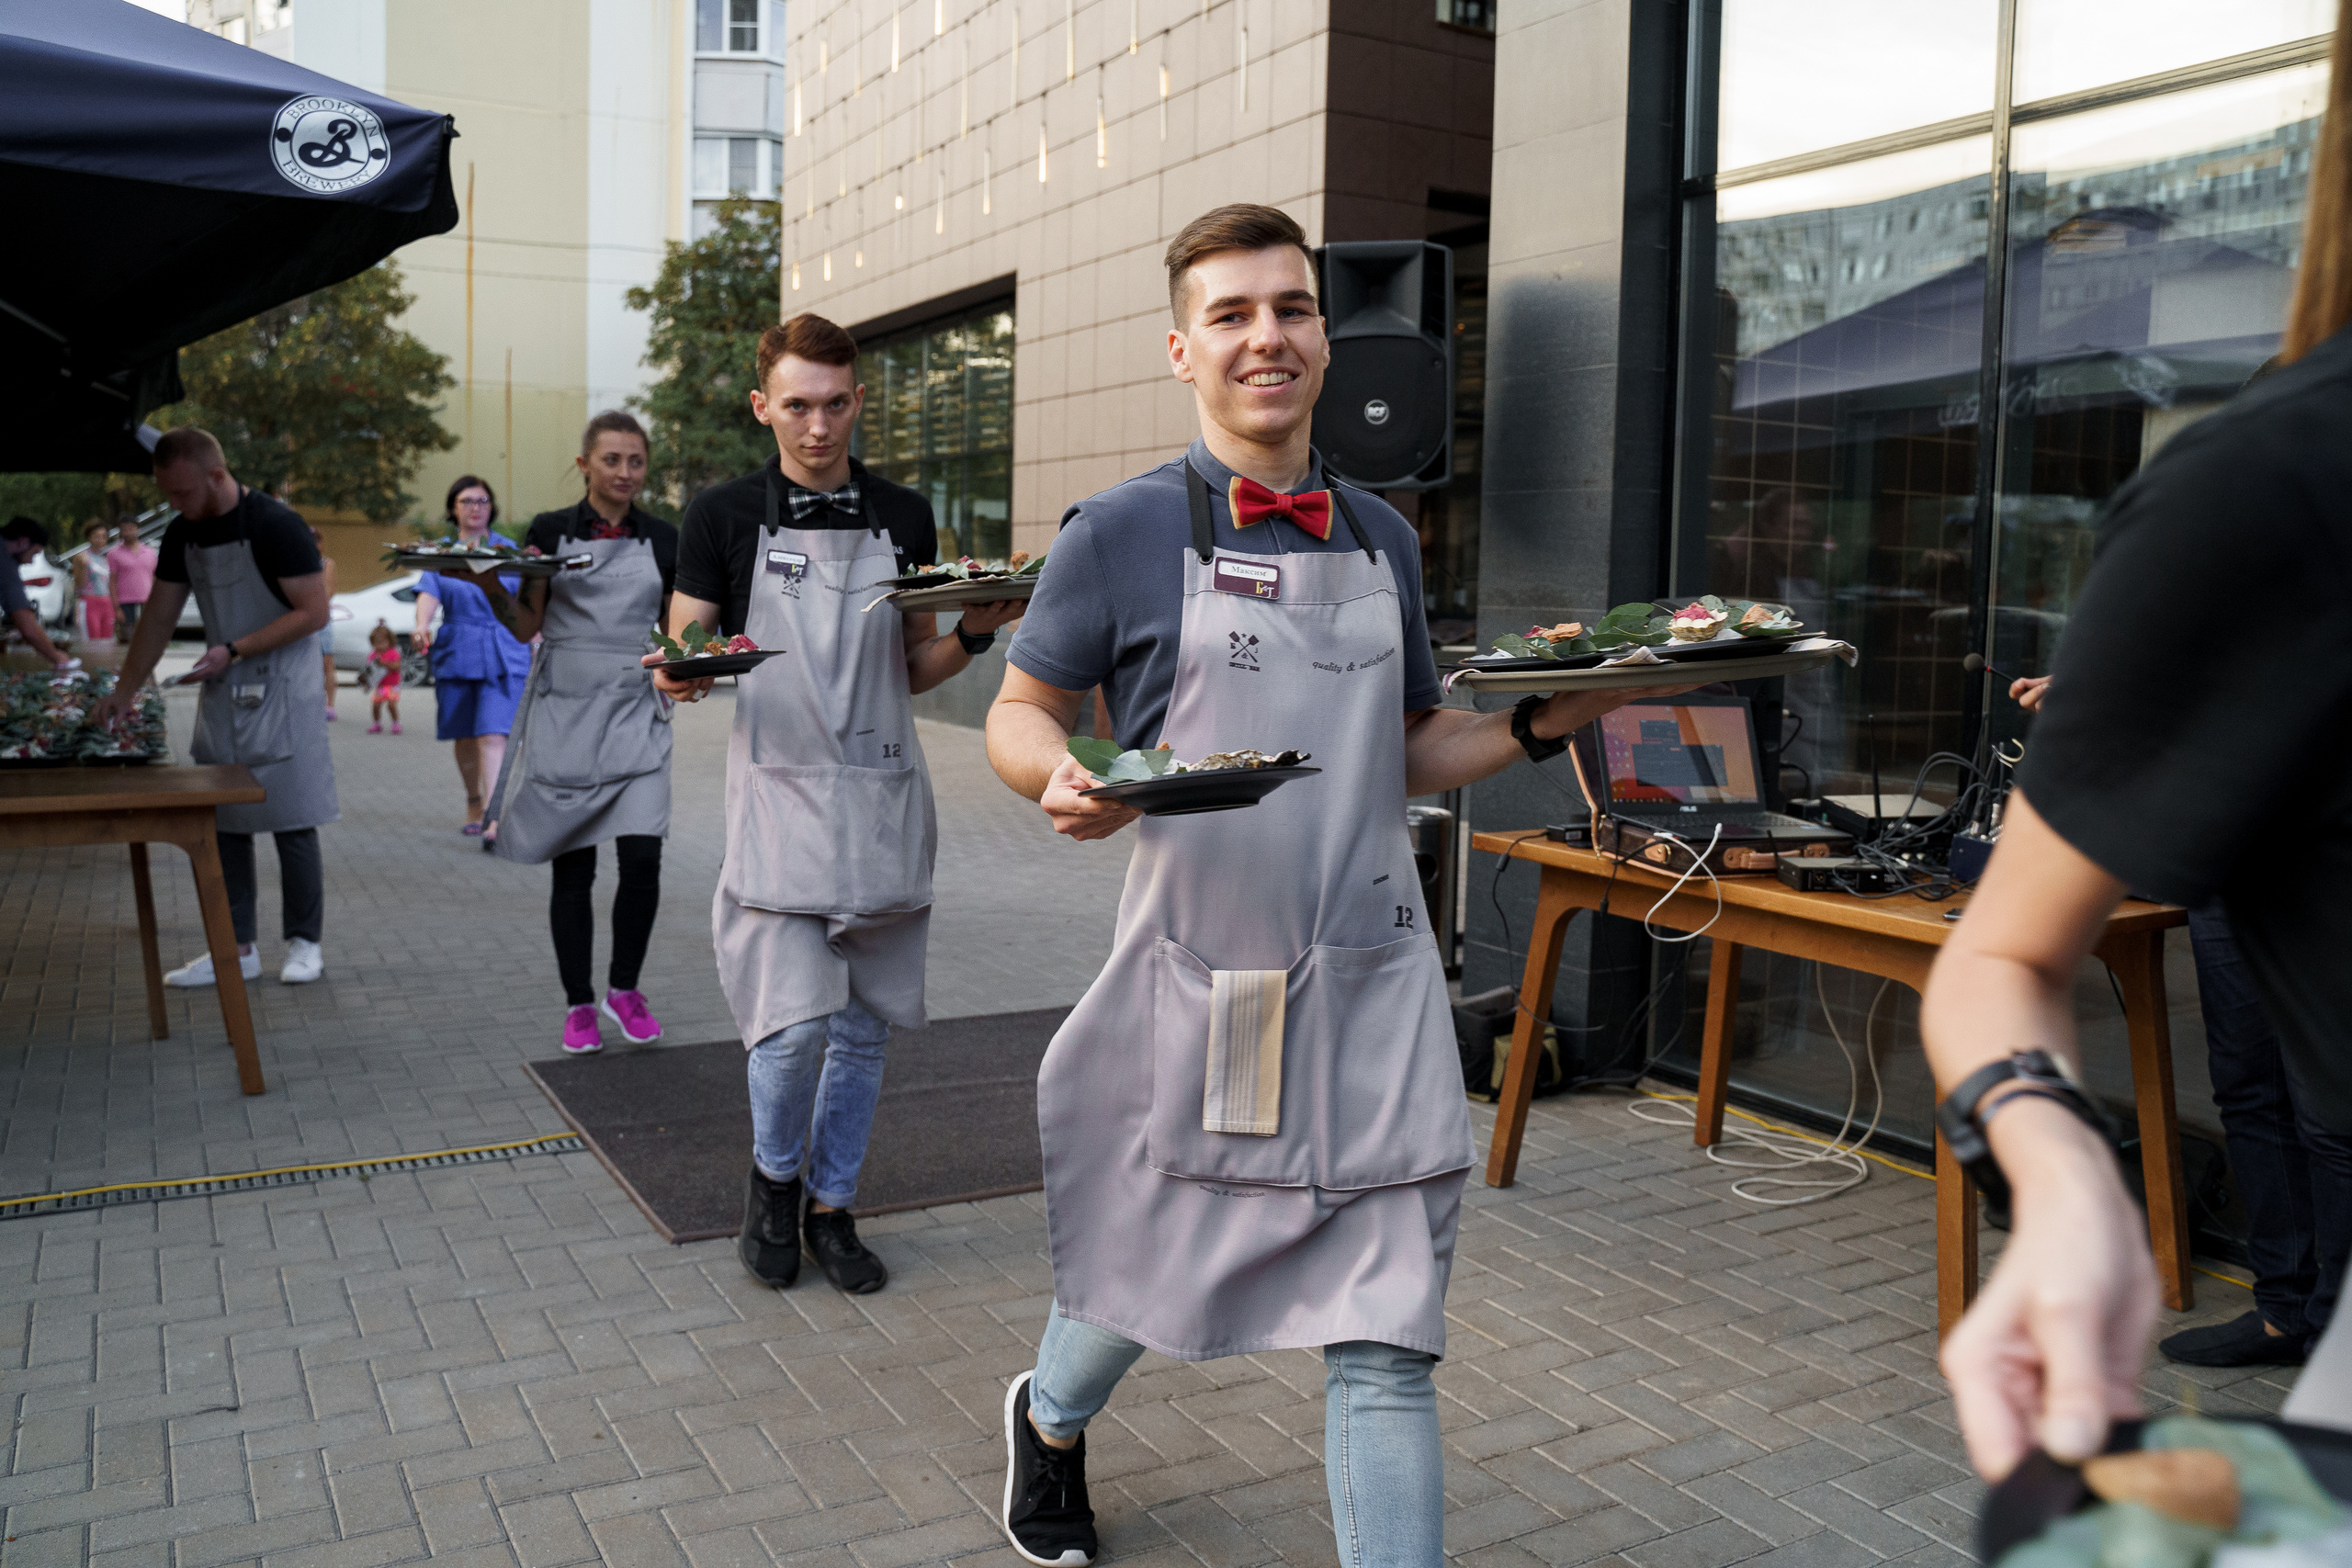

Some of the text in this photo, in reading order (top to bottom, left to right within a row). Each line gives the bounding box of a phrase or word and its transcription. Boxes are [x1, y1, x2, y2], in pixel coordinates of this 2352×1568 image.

[286, 98, 379, 138] BROOKLYN
[283, 160, 371, 189] BREWERY
[1231, 566, 1267, 577] Максим
[1312, 661, 1342, 674] quality
[1346, 661, 1356, 671] &
[883, 743, 901, 759] 12
[1394, 905, 1414, 930] 12
